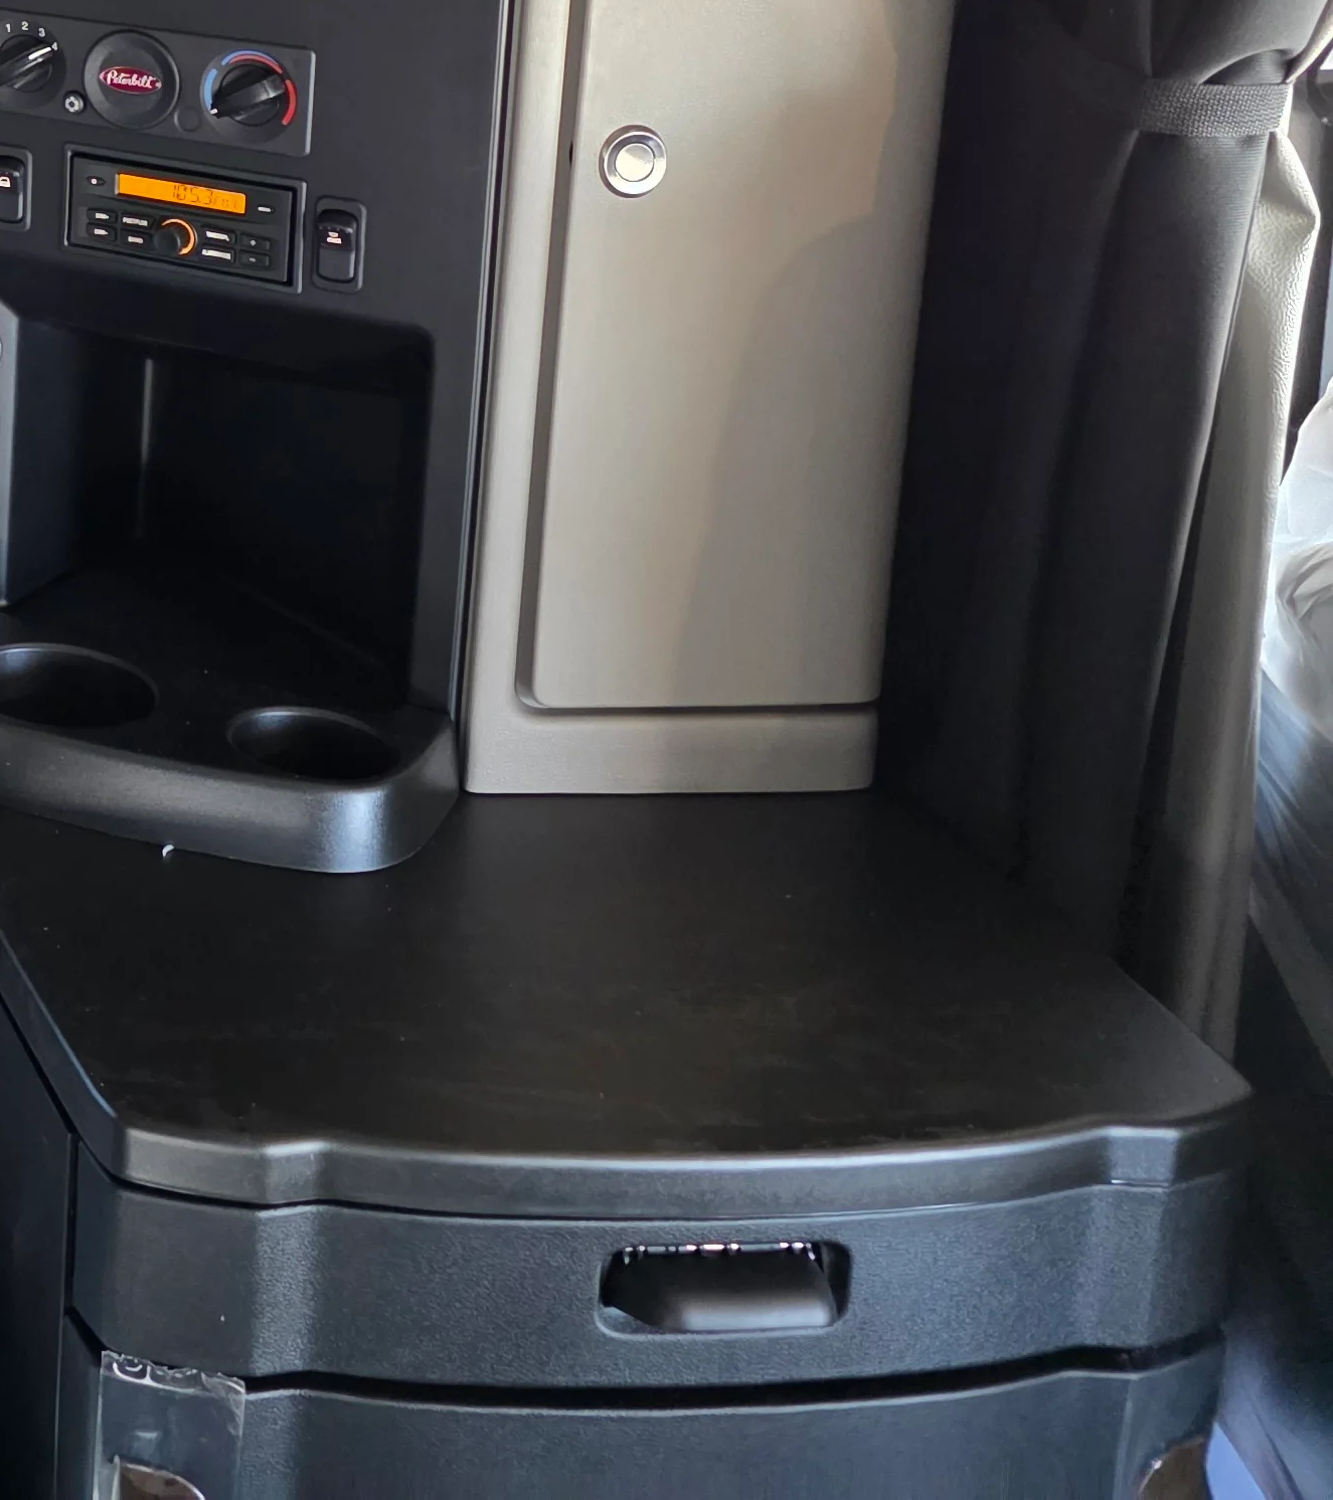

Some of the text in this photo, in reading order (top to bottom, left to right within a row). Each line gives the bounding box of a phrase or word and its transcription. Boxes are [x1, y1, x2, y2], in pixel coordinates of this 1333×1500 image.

[5, 23, 11, 33] 1
[21, 21, 29, 31] 2
[38, 27, 46, 37] 3
[51, 41, 58, 51] 4
[106, 69, 153, 89] Peterbilt
